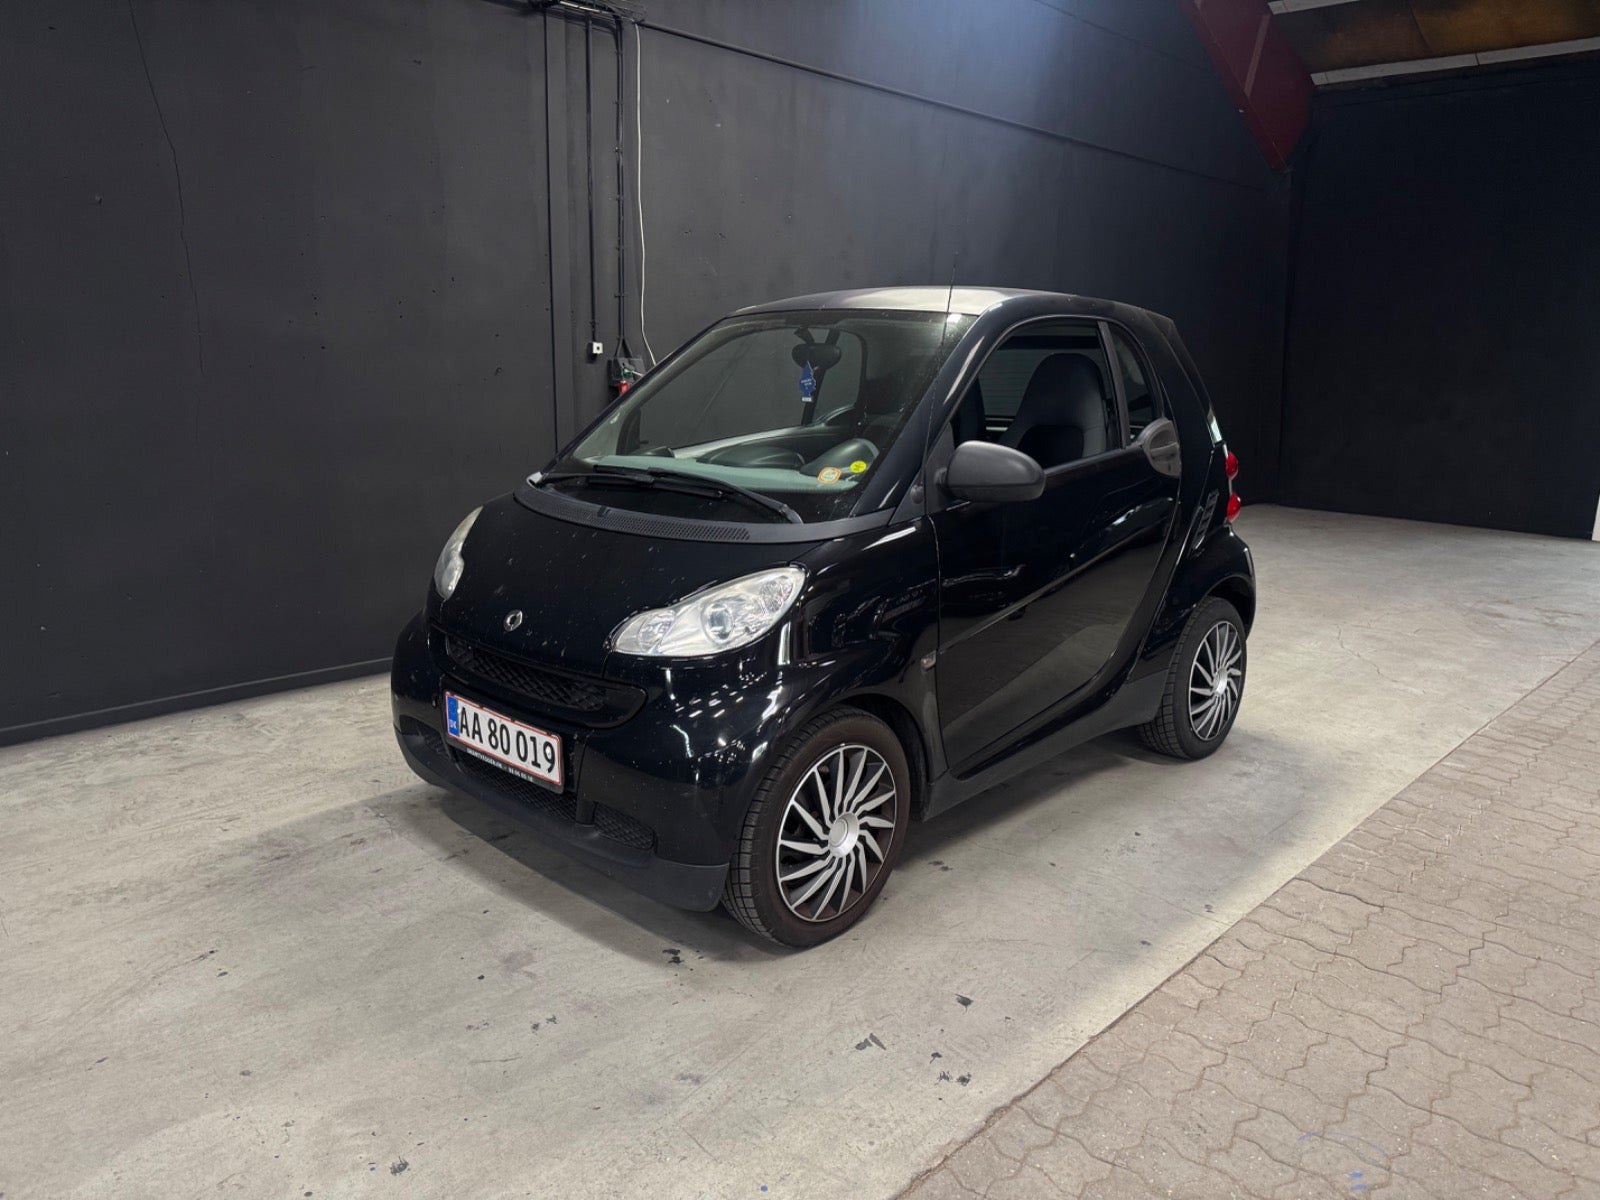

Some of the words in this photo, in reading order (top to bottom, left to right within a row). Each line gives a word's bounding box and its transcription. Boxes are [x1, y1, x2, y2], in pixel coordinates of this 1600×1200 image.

[460, 707, 483, 744] AA
[488, 718, 511, 755] 80
[516, 730, 556, 773] 019
